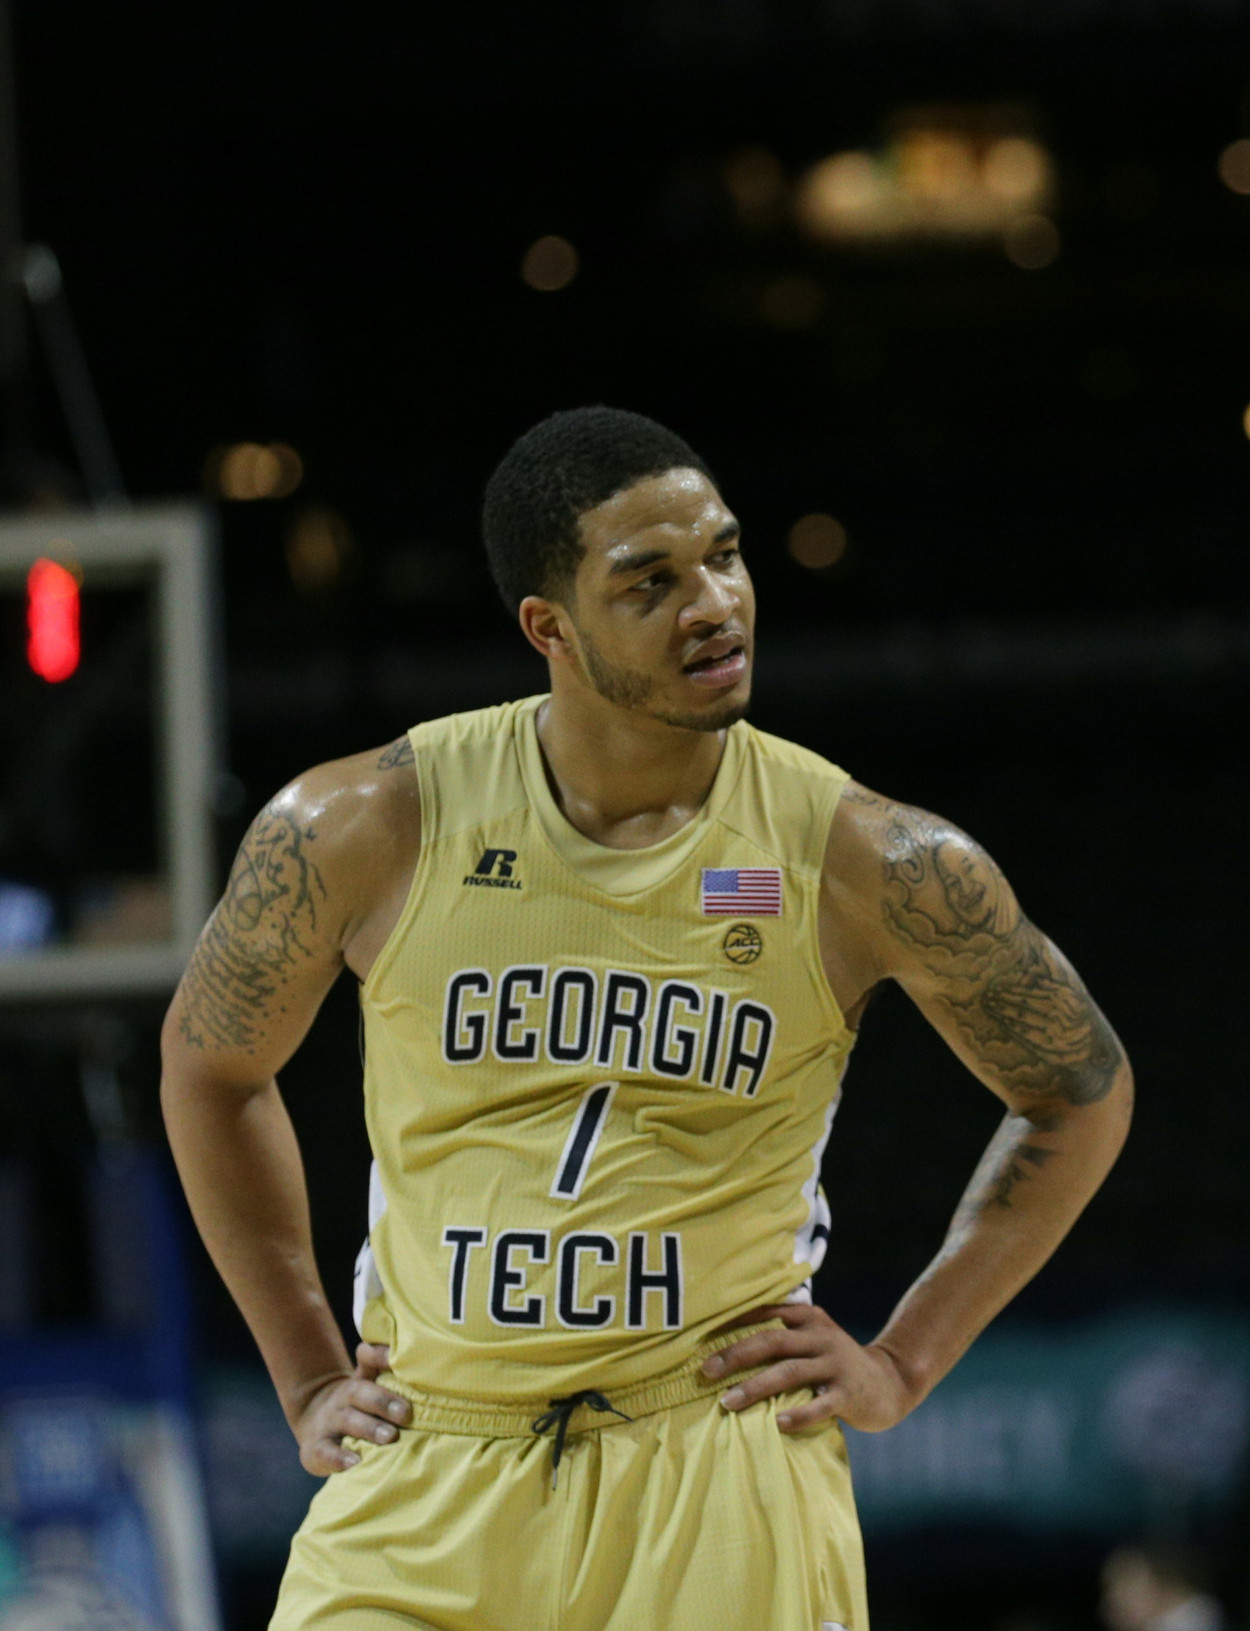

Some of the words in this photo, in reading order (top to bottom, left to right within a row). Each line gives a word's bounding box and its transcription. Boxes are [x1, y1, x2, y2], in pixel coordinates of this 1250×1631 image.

[462, 875, 523, 890] RUSSELL
[475, 848, 517, 878] R
[728, 936, 761, 948] ACC
[441, 964, 777, 1099] GEORGIA
[548, 1080, 620, 1201] 1
[441, 1225, 684, 1331] TECH
